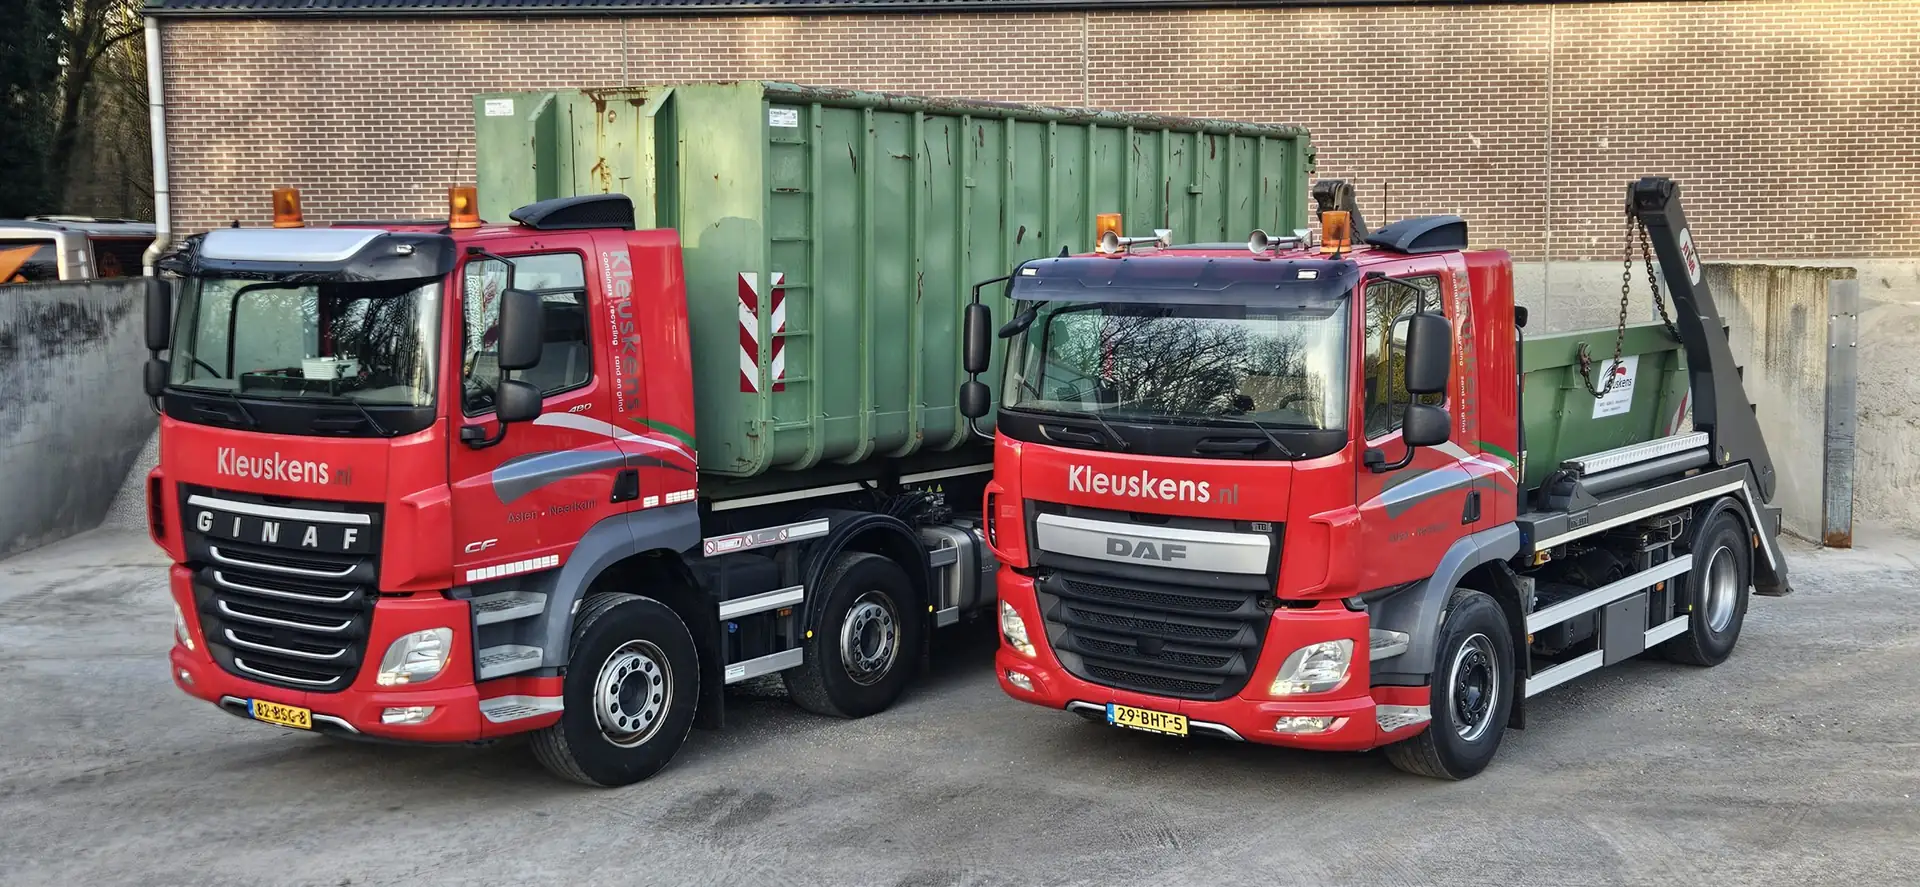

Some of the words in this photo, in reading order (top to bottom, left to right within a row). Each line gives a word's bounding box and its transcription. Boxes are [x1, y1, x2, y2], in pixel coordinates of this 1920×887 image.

[609, 305, 619, 346] recycling
[610, 250, 641, 410] Kleuskens
[196, 510, 358, 550] GINAF
[465, 538, 498, 554] CF
[1106, 537, 1187, 562] DAF
[1117, 706, 1183, 731] 29-BHT-5
